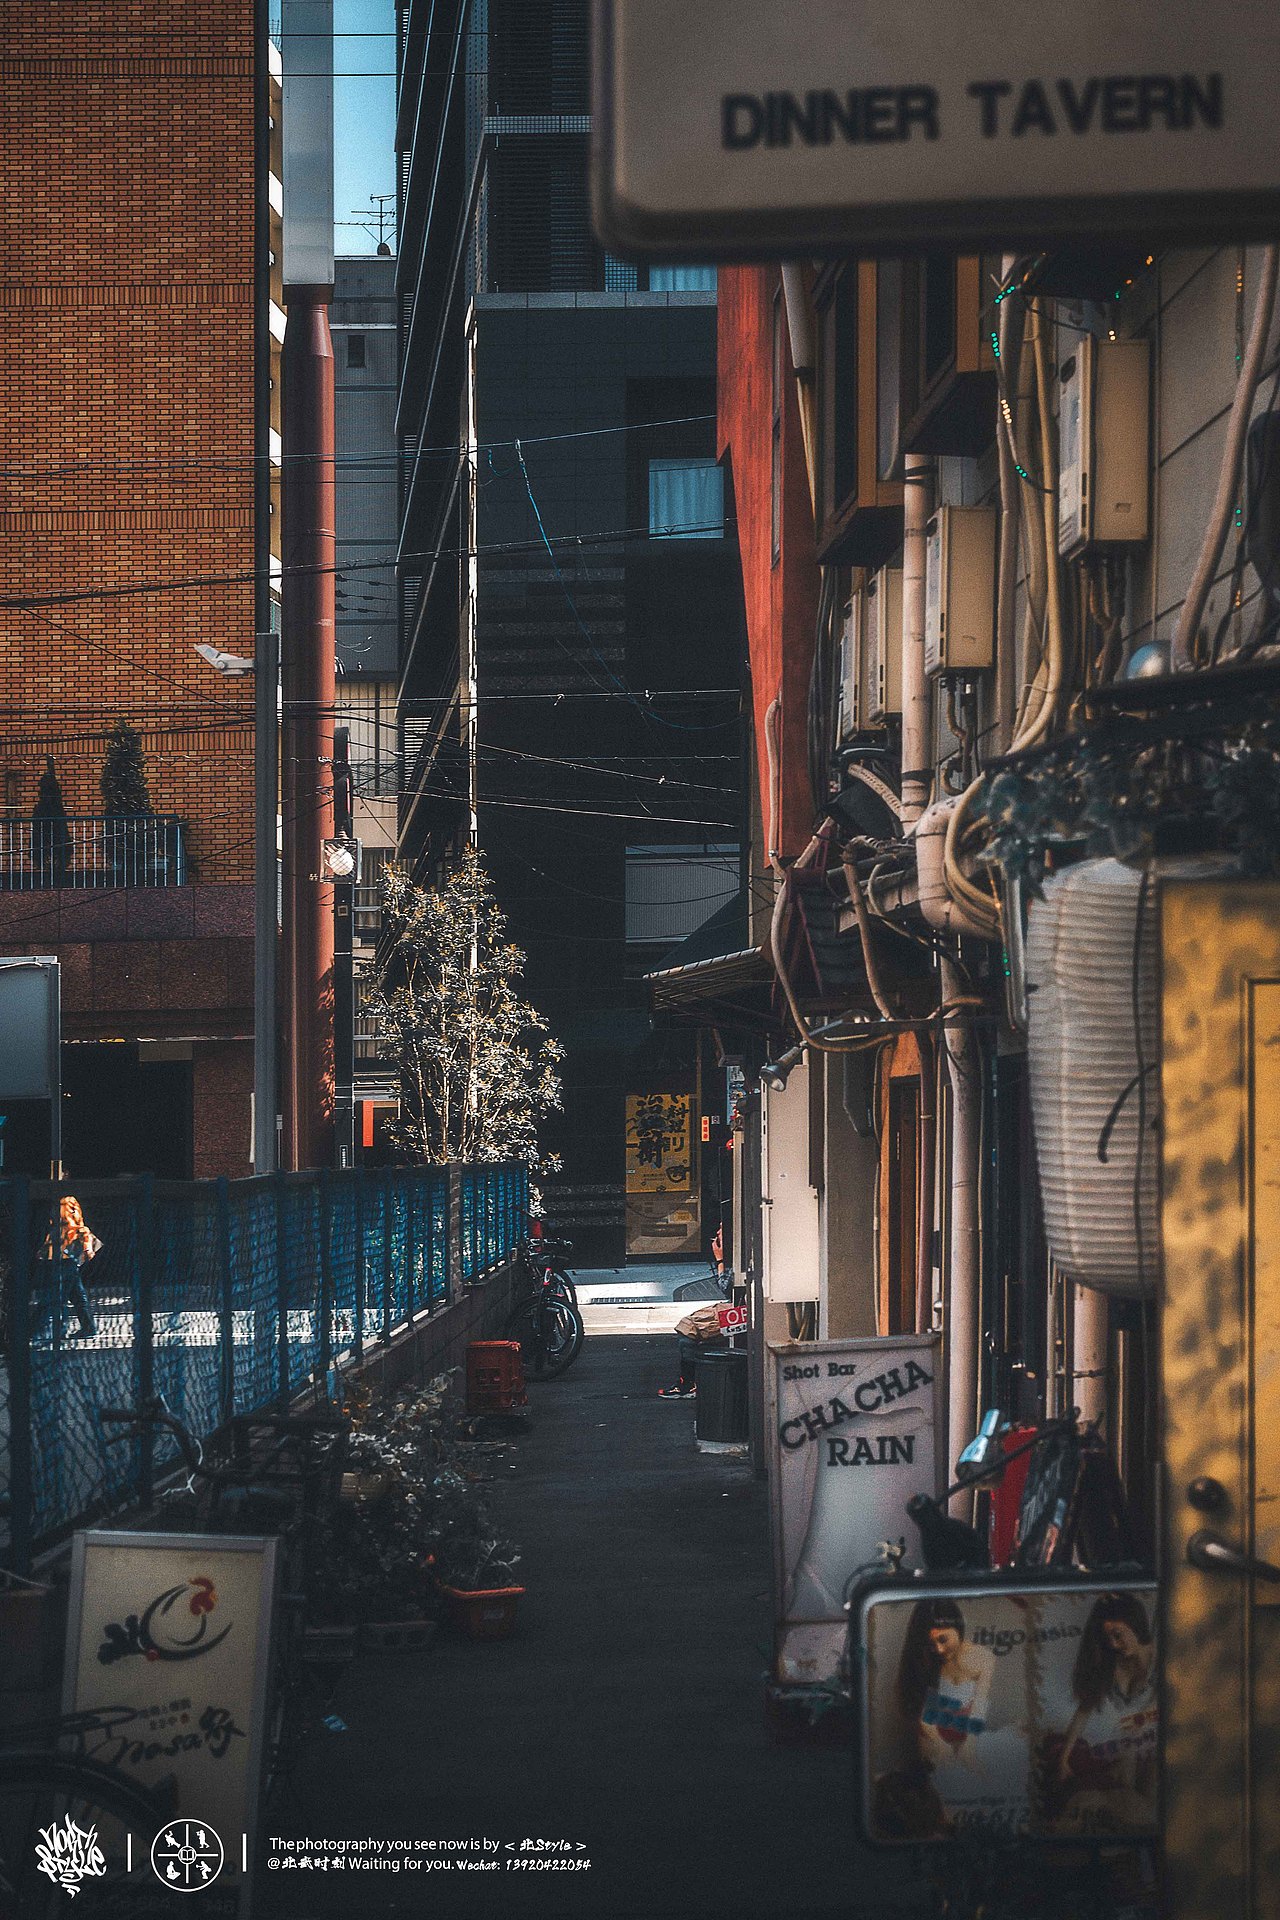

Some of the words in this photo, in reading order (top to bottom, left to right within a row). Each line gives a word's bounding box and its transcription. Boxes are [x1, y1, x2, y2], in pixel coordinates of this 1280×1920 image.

[719, 83, 943, 152] DINNER
[966, 72, 1225, 140] TAVERN
[782, 1363, 820, 1381] Shot
[827, 1362, 857, 1377] Bar
[779, 1397, 857, 1451] CHA
[854, 1360, 934, 1412] CHA
[826, 1435, 916, 1467] RAIN
